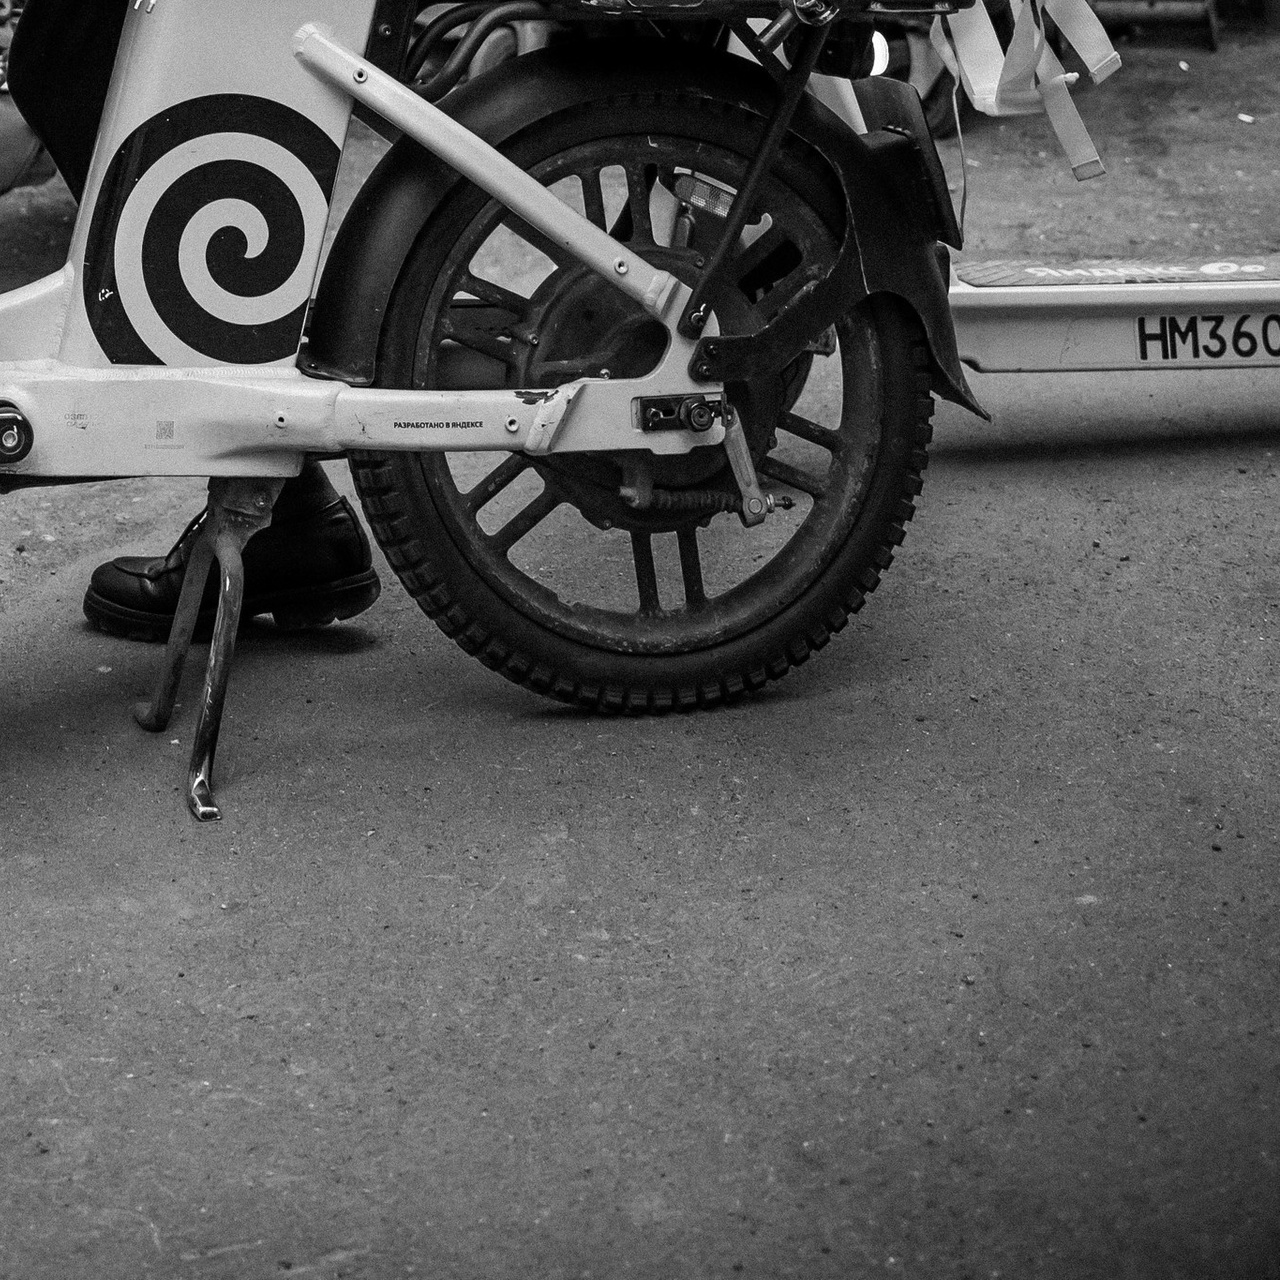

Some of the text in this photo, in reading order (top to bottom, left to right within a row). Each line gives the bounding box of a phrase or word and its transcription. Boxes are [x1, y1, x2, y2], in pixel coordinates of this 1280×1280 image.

[393, 420, 483, 430] РАЗРАБОТАНО В ЯНДЕКСЕ
